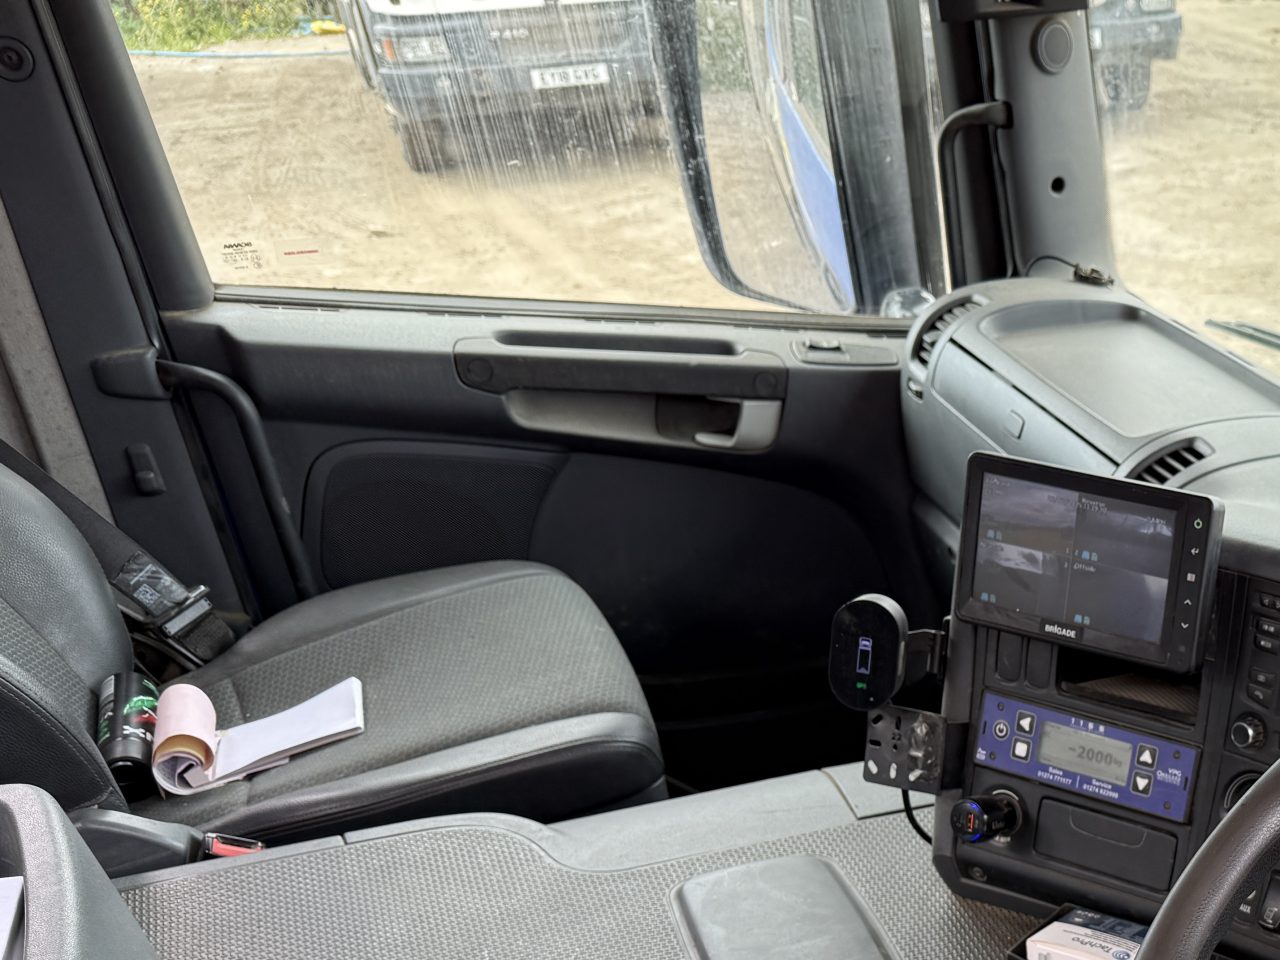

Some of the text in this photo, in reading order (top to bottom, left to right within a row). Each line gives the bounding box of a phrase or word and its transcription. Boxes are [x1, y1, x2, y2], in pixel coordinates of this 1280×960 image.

[1044, 623, 1076, 638] BRIGADE
[1239, 902, 1252, 914] AUX
[1071, 936, 1113, 953] TachPro
